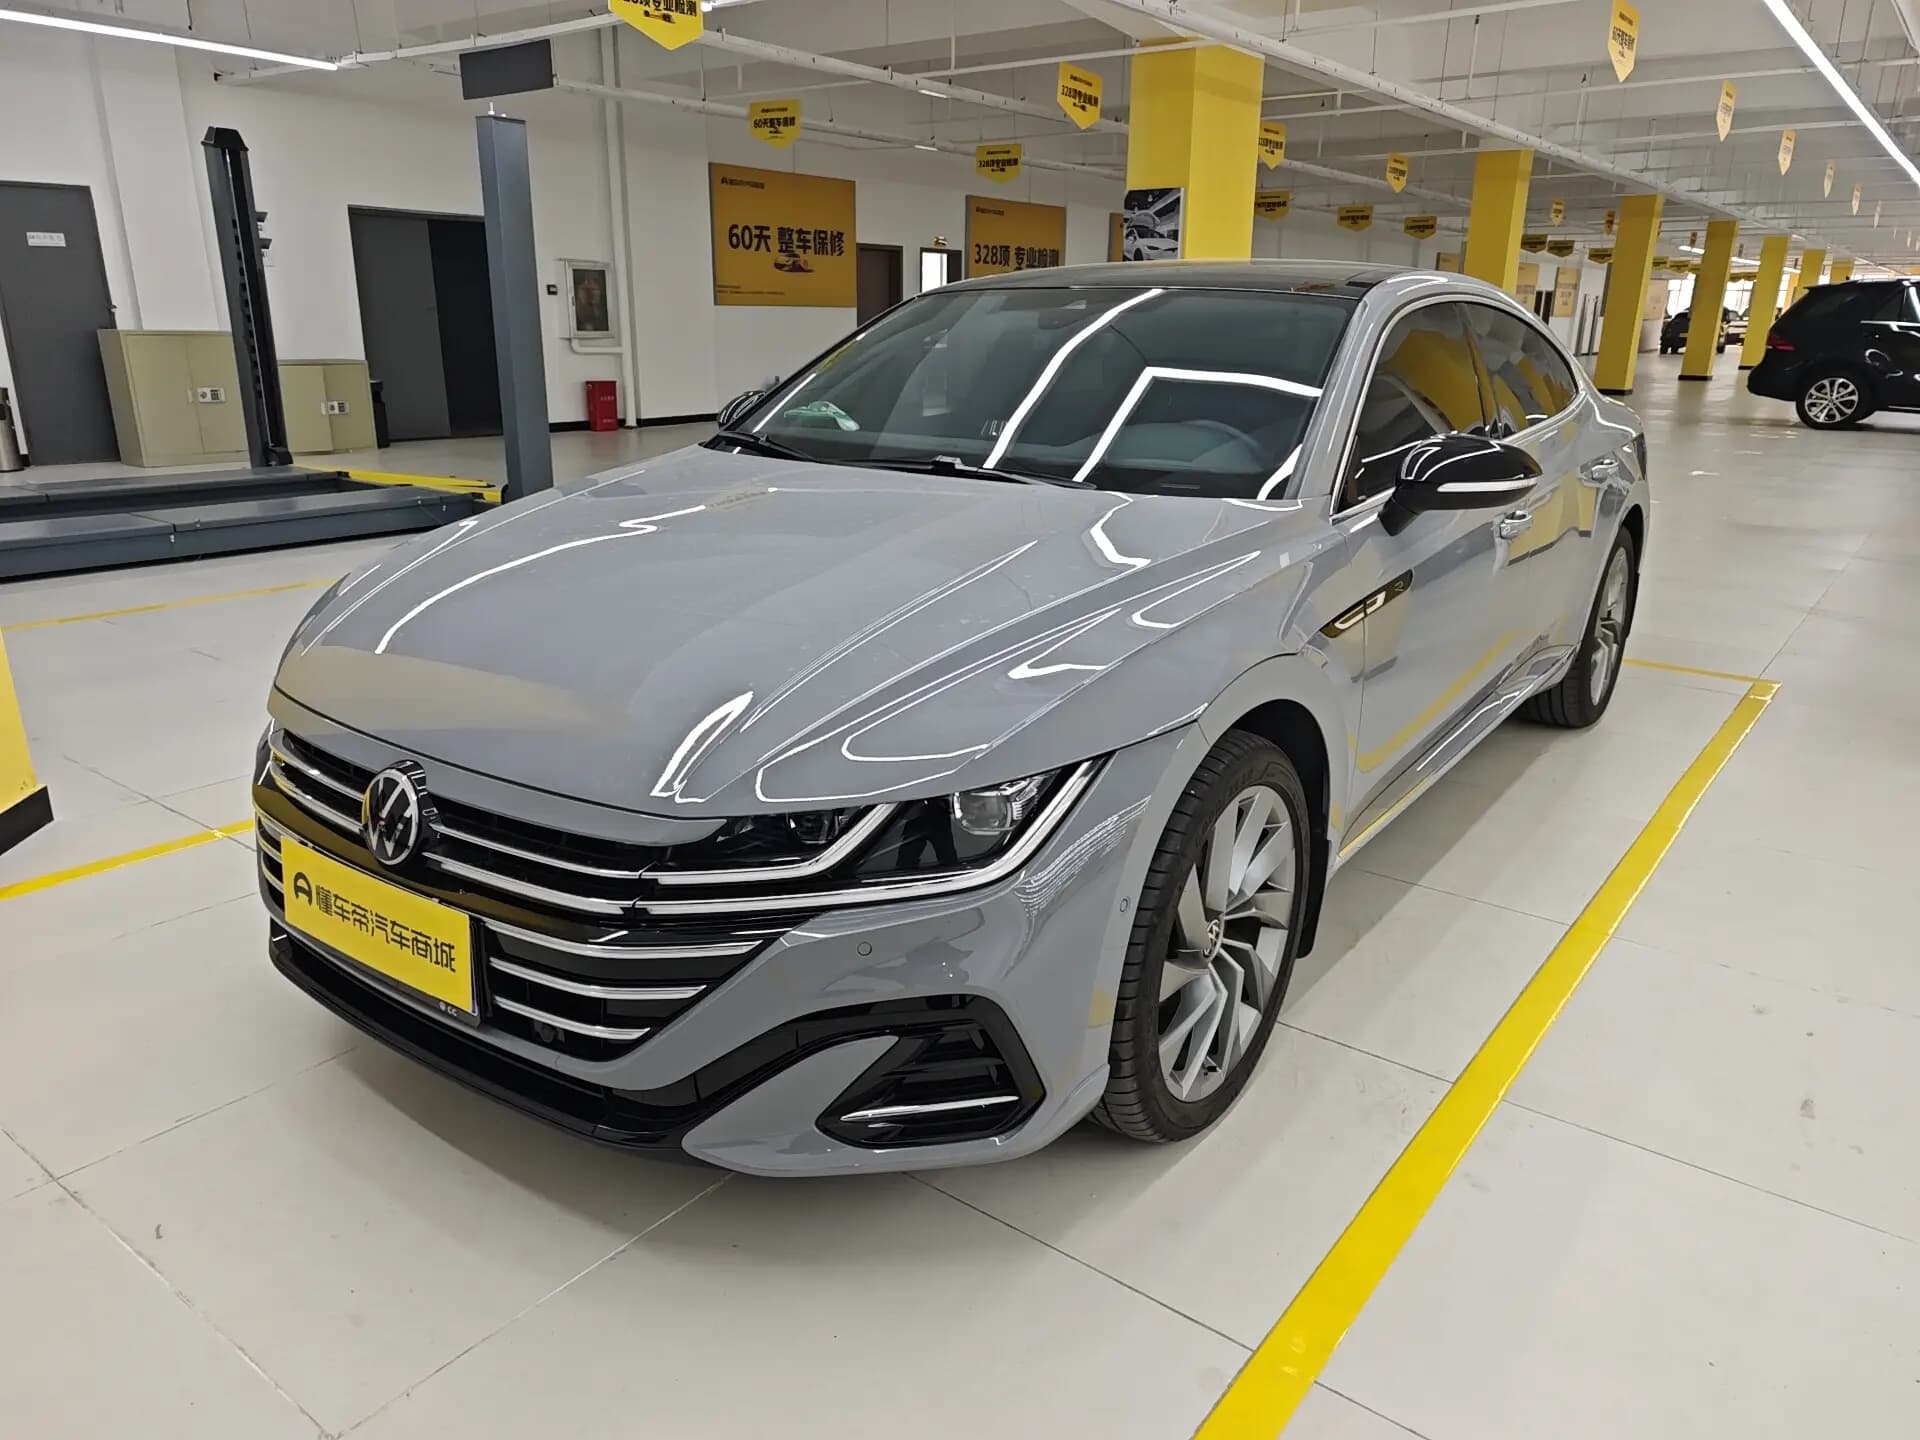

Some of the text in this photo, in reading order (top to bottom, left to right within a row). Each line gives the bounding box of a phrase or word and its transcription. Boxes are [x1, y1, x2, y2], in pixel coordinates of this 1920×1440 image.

[728, 223, 845, 257] 60天 整车保修
[974, 243, 1010, 267] 328项
[315, 884, 457, 974] 懂车帝汽车商城
